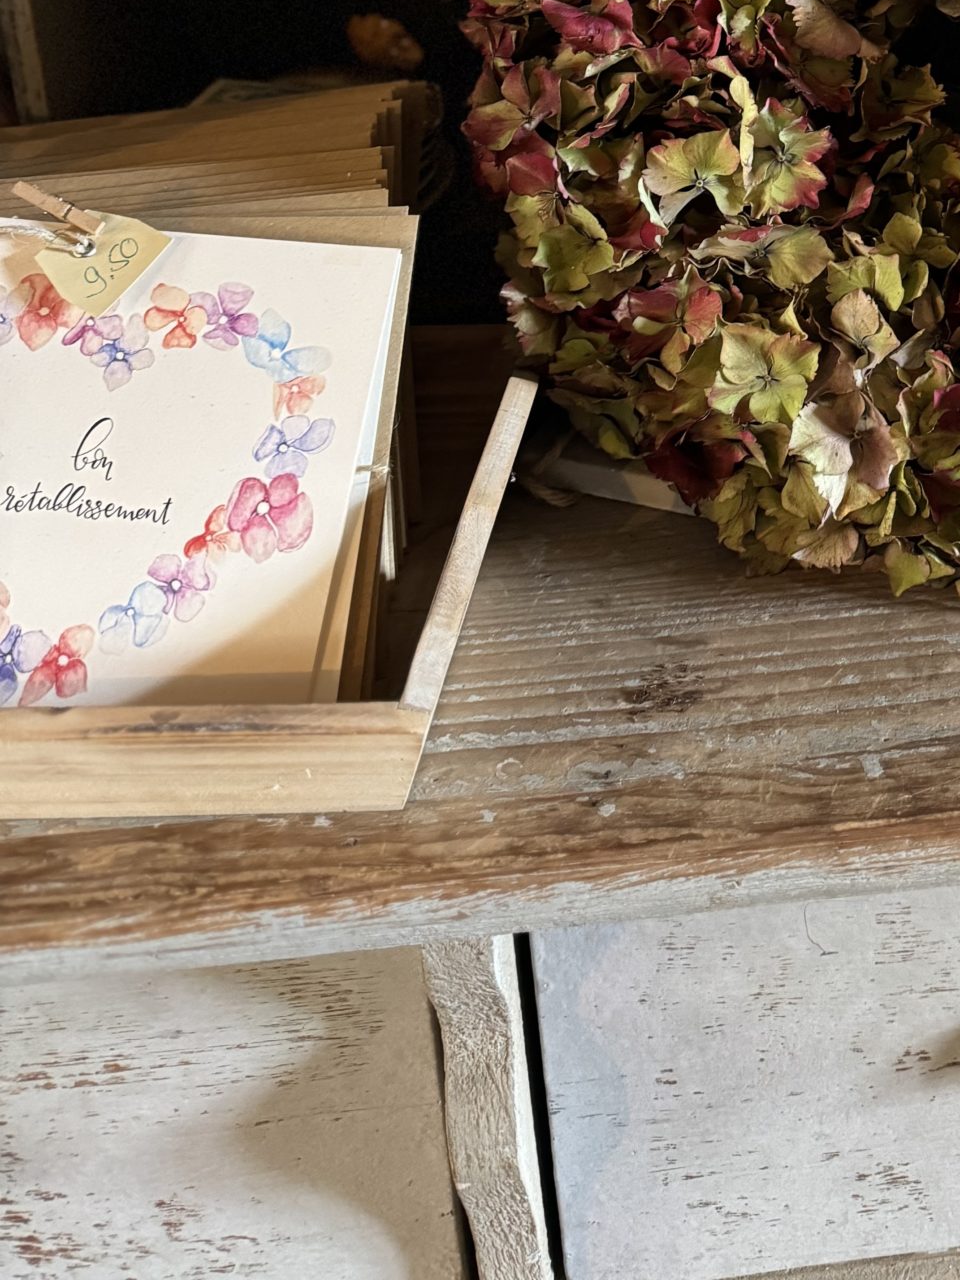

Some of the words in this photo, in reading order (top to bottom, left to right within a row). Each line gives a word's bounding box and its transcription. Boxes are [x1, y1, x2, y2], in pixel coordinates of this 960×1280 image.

[83, 237, 140, 299] 9.50
[70, 416, 115, 482] bon
[0, 481, 174, 526] rétablissement
